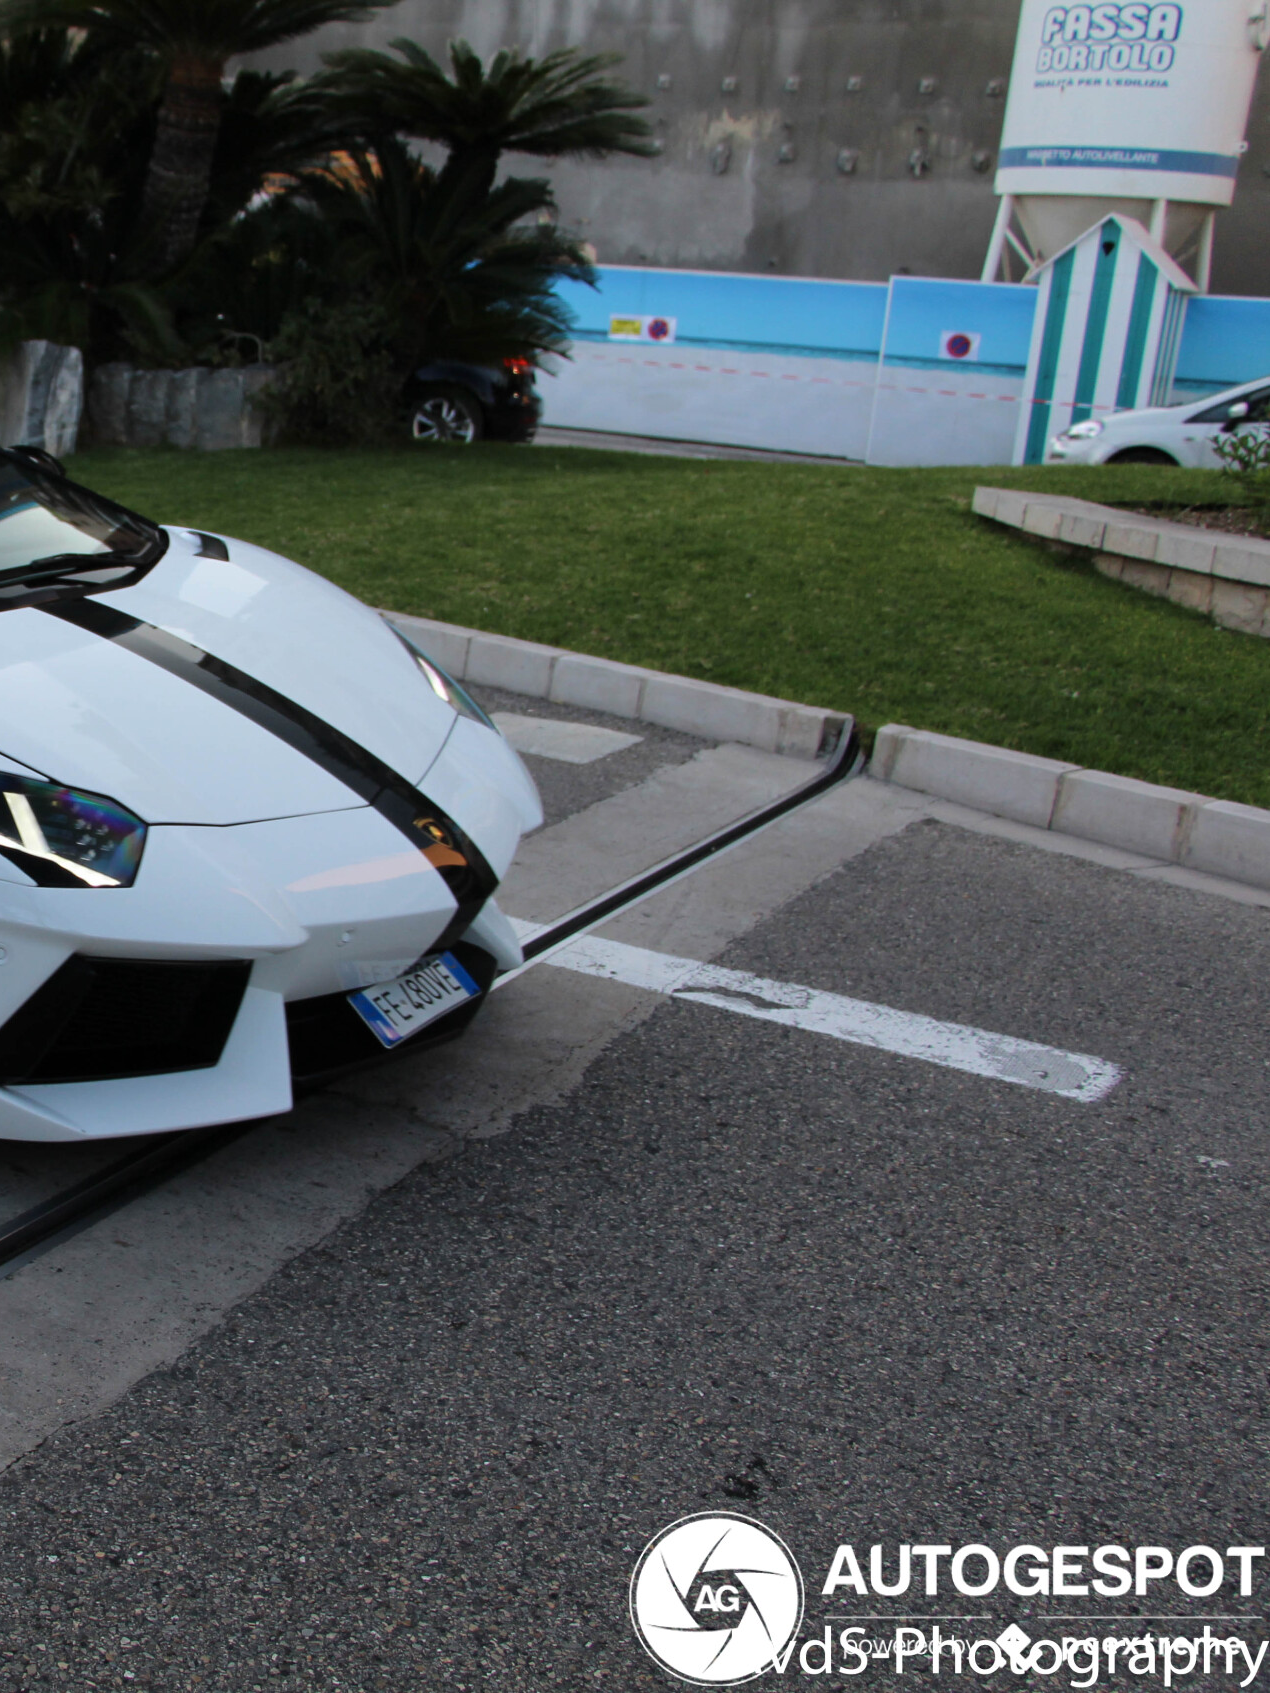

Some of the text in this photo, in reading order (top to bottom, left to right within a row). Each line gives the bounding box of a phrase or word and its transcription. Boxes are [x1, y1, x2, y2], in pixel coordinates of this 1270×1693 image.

[1041, 1, 1183, 44] FASSA
[1036, 43, 1175, 73] BORTOLO
[1077, 78, 1102, 87] PER
